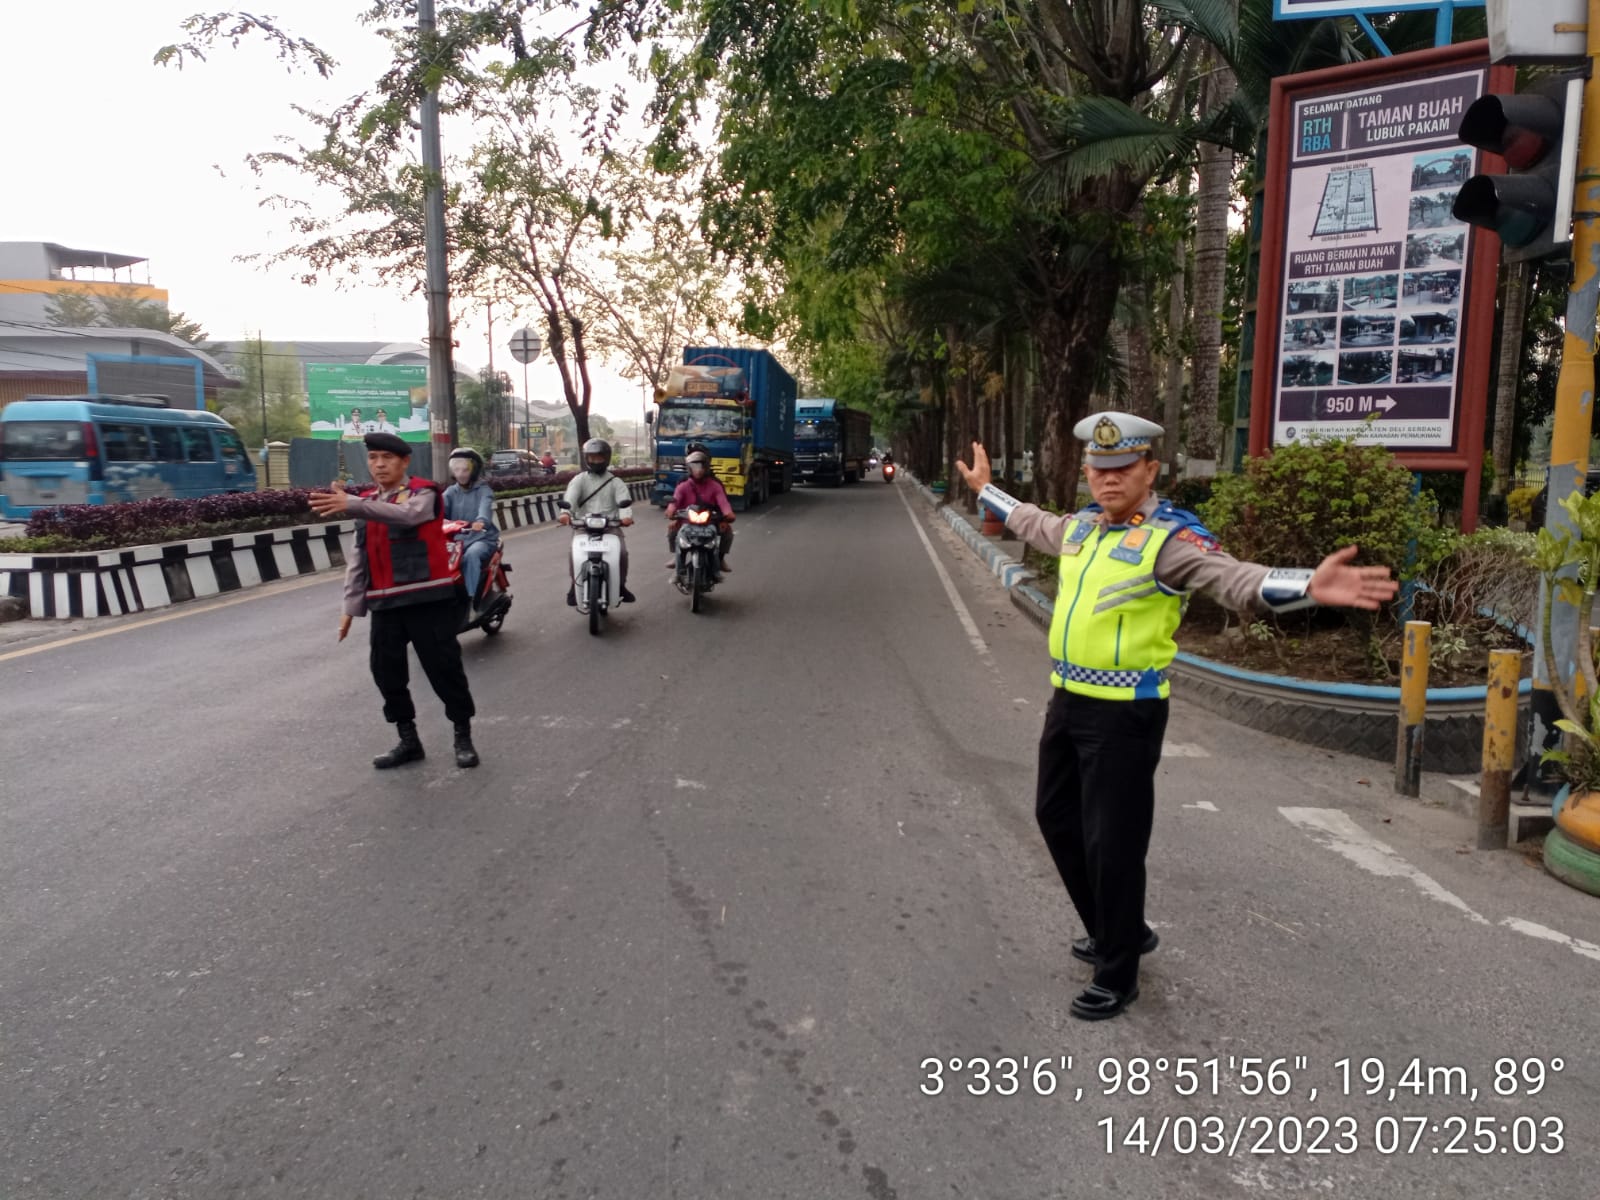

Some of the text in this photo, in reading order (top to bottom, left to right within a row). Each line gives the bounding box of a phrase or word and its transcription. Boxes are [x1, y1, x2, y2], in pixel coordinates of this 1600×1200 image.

[1303, 94, 1383, 116] SELAMAT DATANG
[1358, 95, 1464, 129] TAMAN BUAH
[1303, 117, 1333, 136] RTH
[1366, 118, 1450, 142] LUBUK PAKAM
[1302, 134, 1332, 153] RBA
[1294, 244, 1396, 265] RUANG BERMAIN ANAK
[1304, 258, 1384, 275] RTH TAMAN BUAH
[1326, 396, 1373, 413] 950 M
